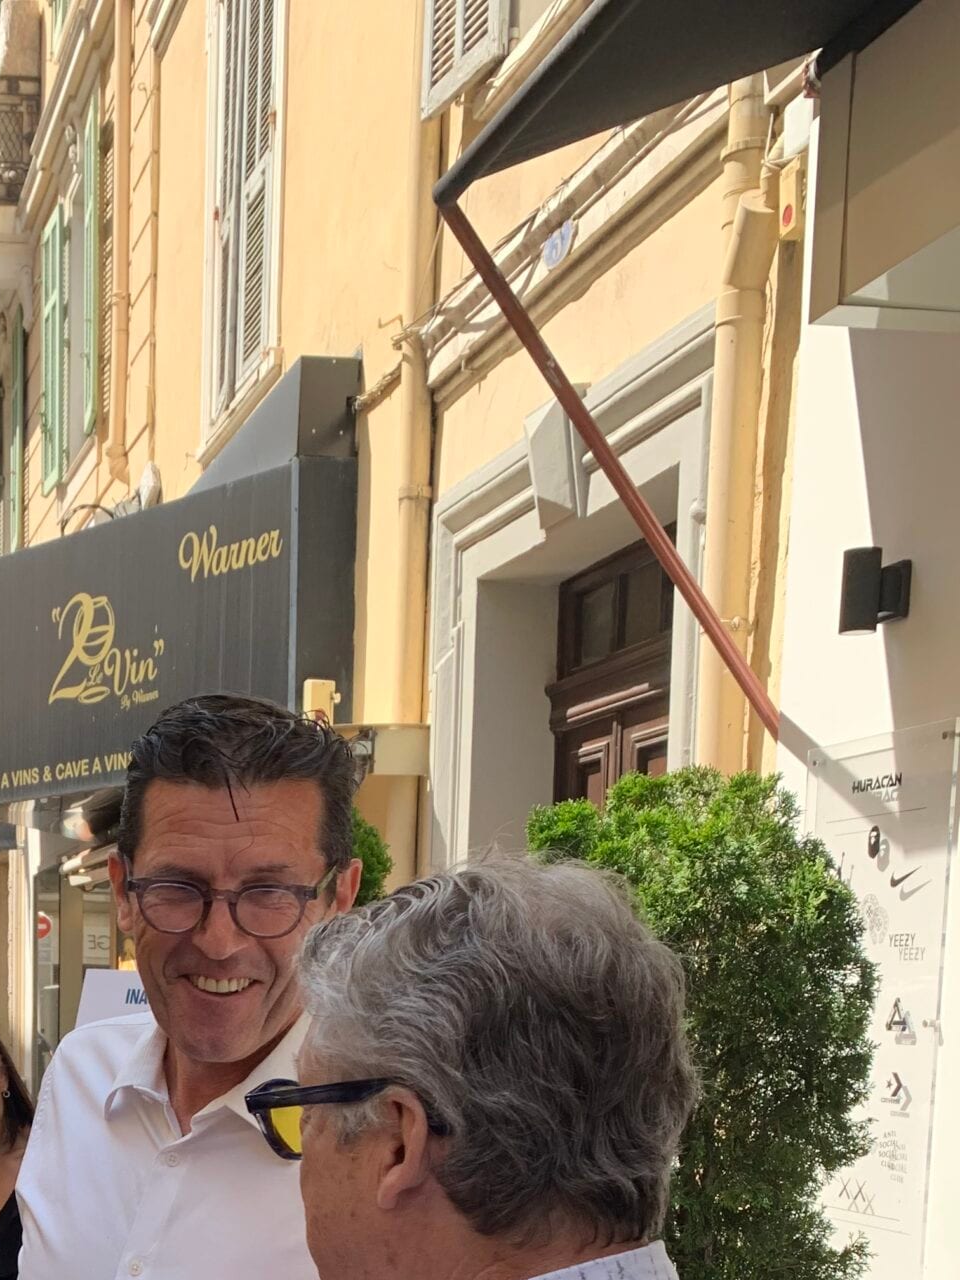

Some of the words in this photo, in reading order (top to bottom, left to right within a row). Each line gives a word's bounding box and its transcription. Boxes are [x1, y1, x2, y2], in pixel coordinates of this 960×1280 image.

[178, 524, 283, 582] Warner
[1, 772, 10, 790] A
[11, 768, 40, 788] VINS
[43, 765, 53, 783] &
[55, 759, 90, 781] CAVE
[92, 757, 102, 774] A
[852, 773, 902, 793] HURACAN
[889, 933, 916, 947] YEEZY
